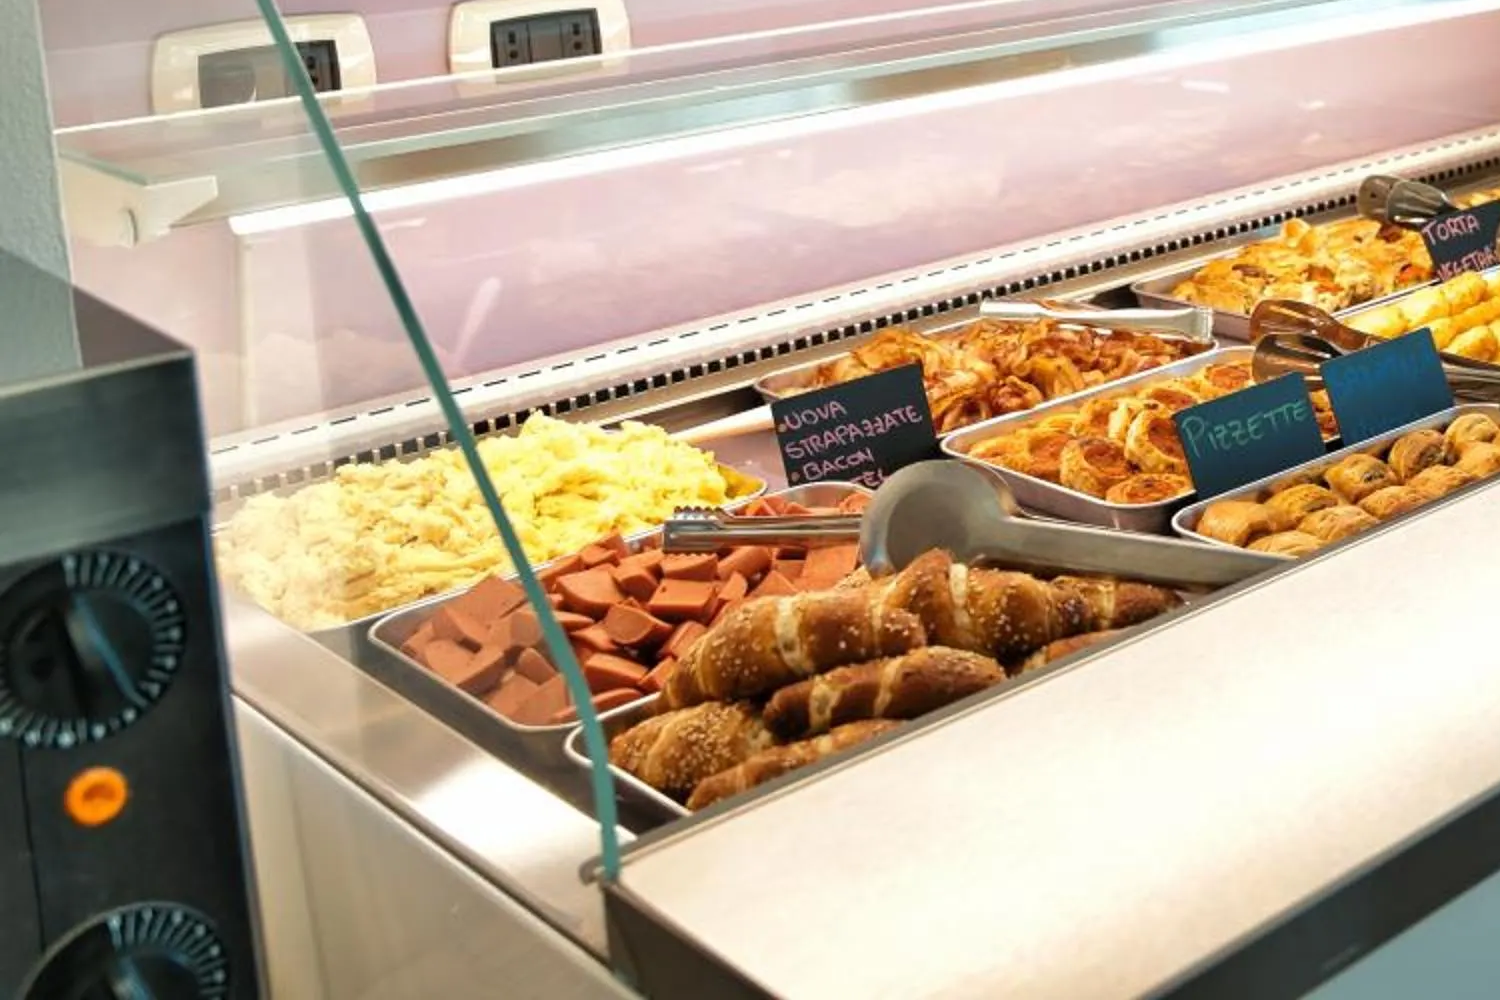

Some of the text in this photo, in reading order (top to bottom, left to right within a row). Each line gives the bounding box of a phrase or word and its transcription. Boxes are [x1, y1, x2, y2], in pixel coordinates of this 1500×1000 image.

[1422, 213, 1480, 246] TORTA
[784, 401, 847, 430] UOVA
[1181, 400, 1308, 459] PIZZETTE
[803, 447, 875, 481] BACON
